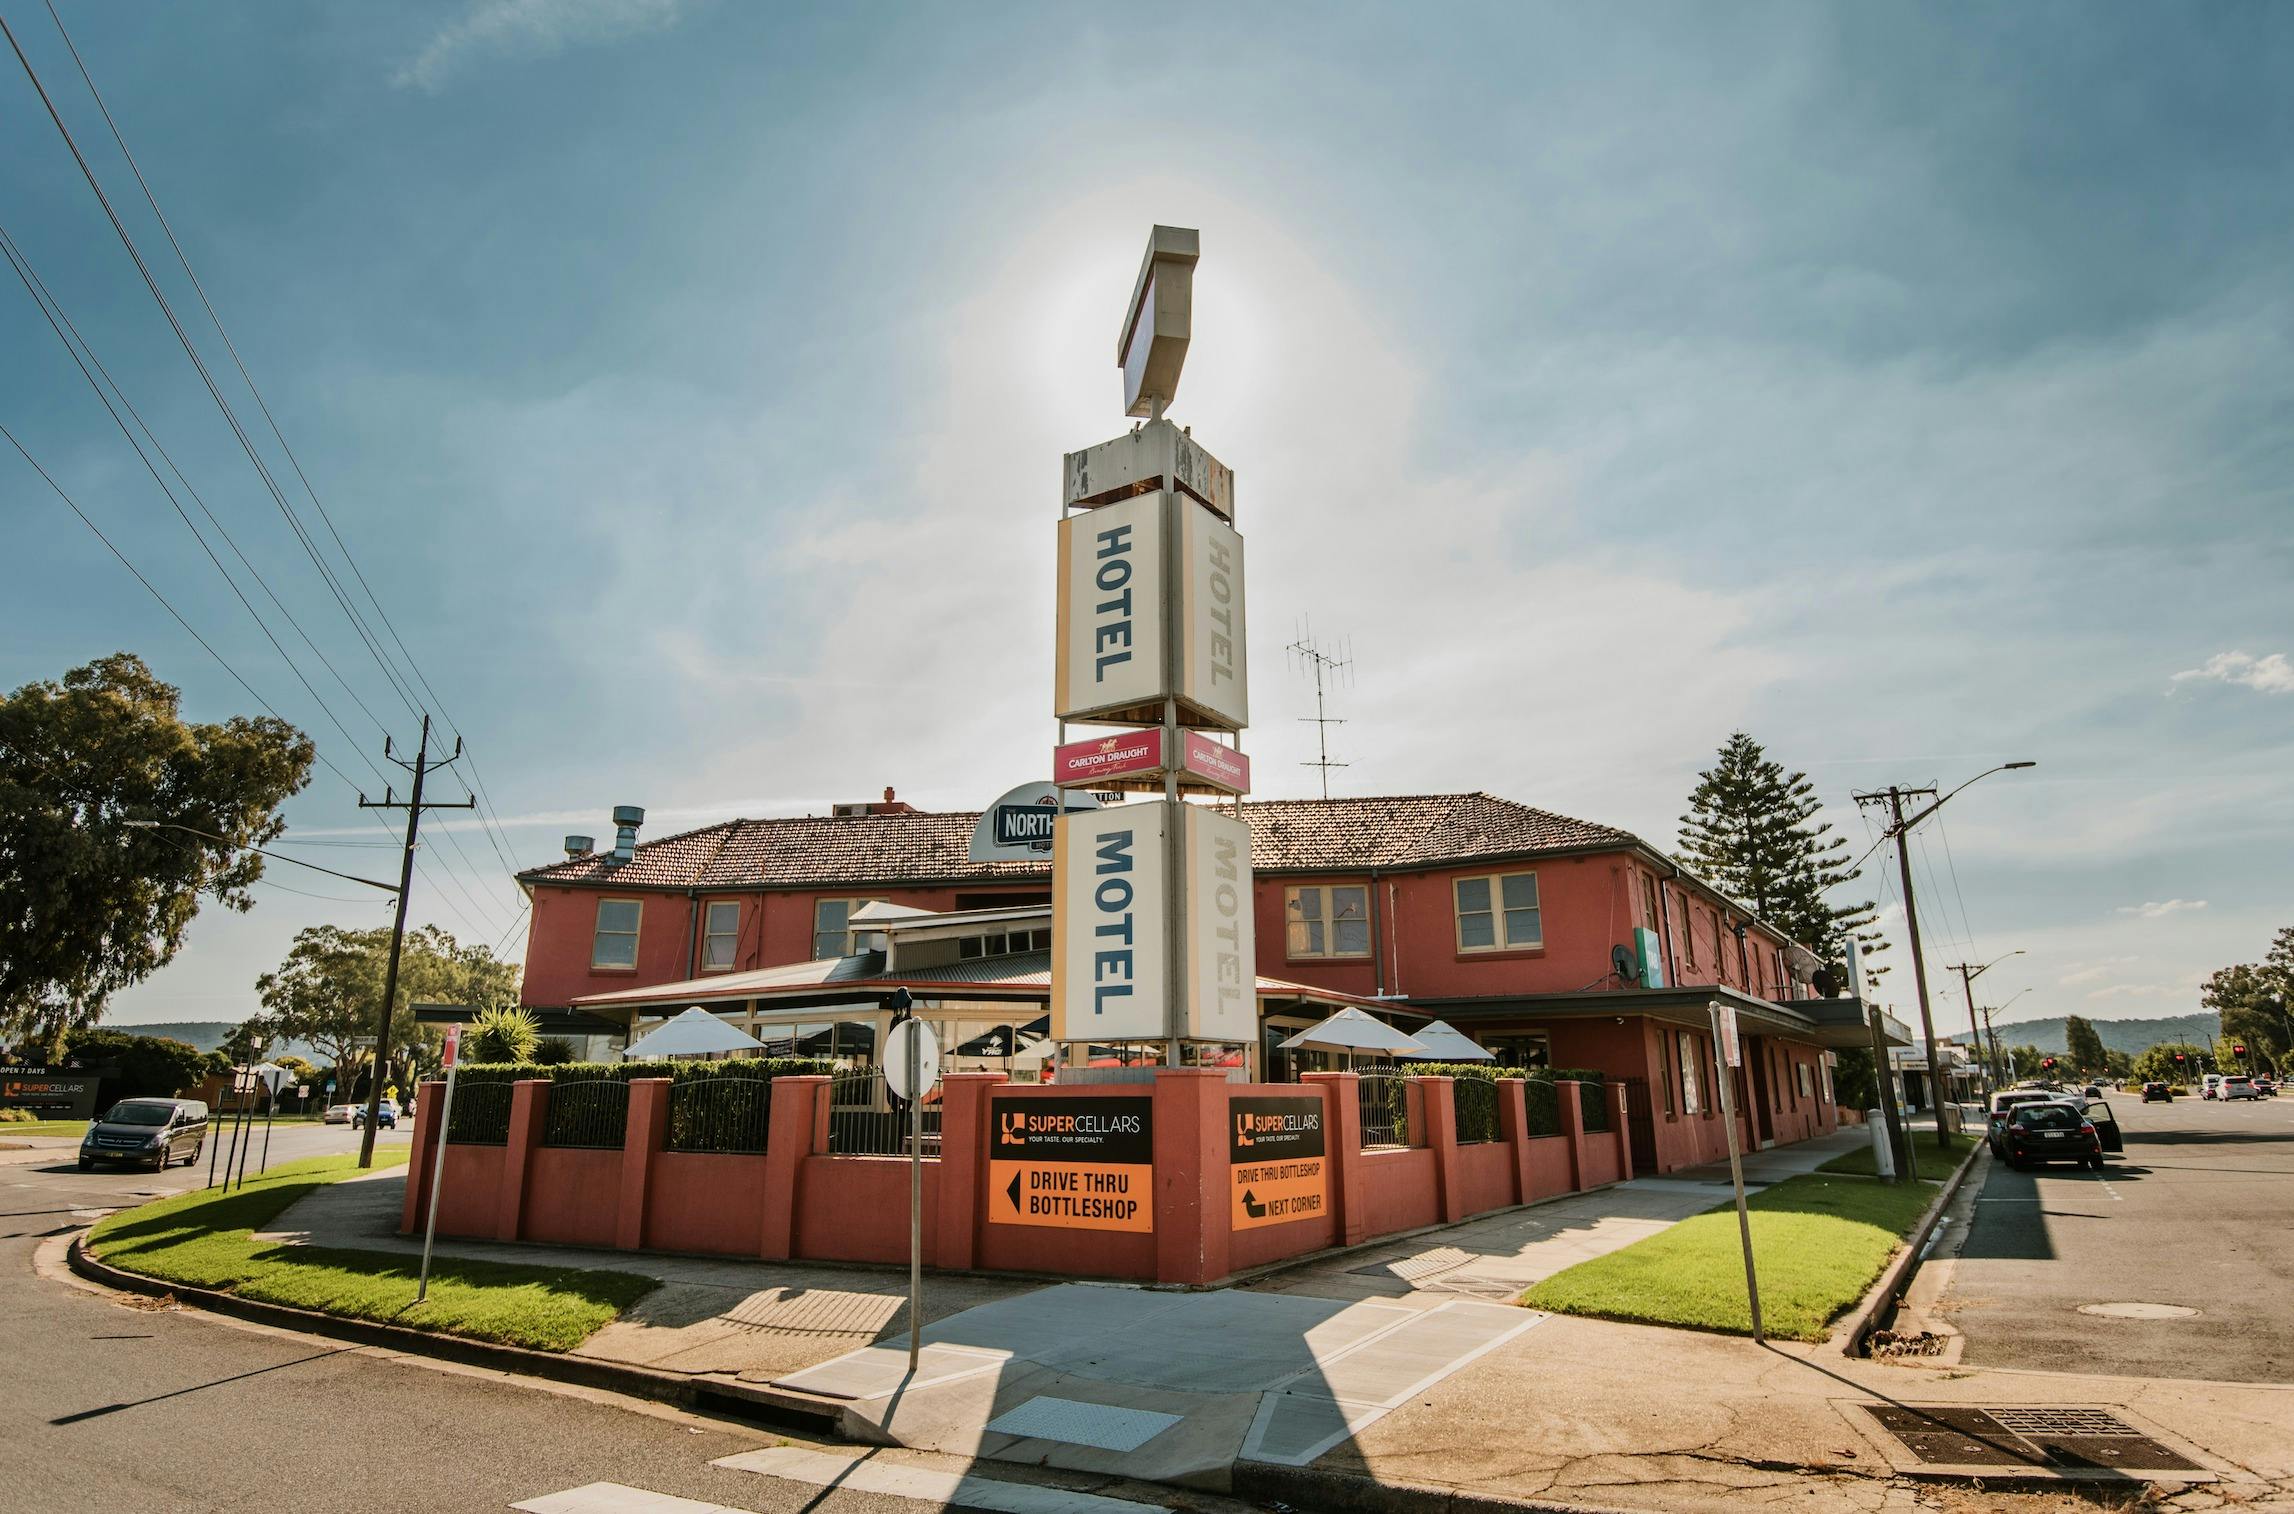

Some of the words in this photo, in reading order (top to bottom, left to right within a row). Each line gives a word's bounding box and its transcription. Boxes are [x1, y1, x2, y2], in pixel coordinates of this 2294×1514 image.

[1096, 524, 1132, 683] HOTEL
[1208, 535, 1233, 686] HOTEL
[1068, 751, 1106, 769] CARLTON
[1107, 746, 1149, 762] DRAUGHT
[1193, 749, 1217, 767] CARLTON
[1217, 759, 1241, 777] DRAUGHT
[1094, 829, 1134, 1015] MOTEL
[1214, 834, 1241, 1016] MOTEL
[27, 1067, 46, 1075] DAYS
[22, 1083, 84, 1093] SUPERCELLARS
[1028, 1115, 1140, 1134] SUPERCELLARS
[1255, 1114, 1319, 1133] SUPERCELLARS
[1075, 1136, 1104, 1144] SPECIALTY.
[1030, 1171, 1078, 1191] DRIVE
[1084, 1173, 1129, 1194] THRU
[1237, 1168, 1259, 1184] DRIVE
[1260, 1166, 1279, 1182] THRU
[1280, 1163, 1321, 1179] BOTTLESHOP
[1030, 1196, 1137, 1219] BOTTLESHOP
[1268, 1199, 1289, 1217] NEXT
[1291, 1194, 1321, 1213] CORNER
